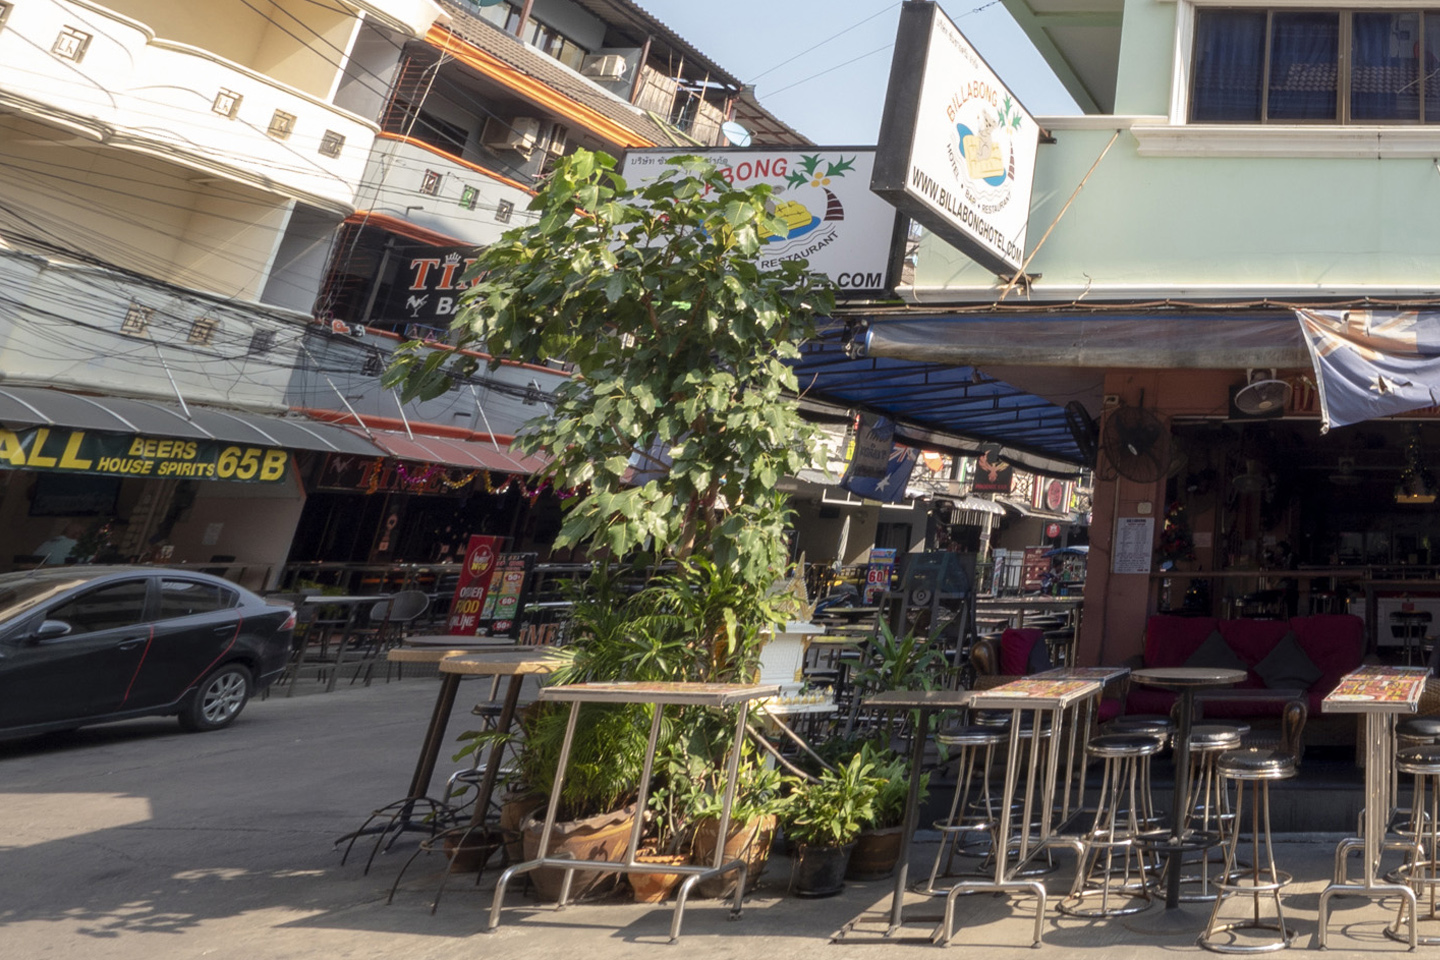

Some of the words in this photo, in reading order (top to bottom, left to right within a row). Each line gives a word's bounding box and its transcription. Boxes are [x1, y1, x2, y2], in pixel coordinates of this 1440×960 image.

[946, 80, 998, 124] BILLABONG
[946, 143, 960, 181] HOTEL
[964, 189, 977, 208] BAR
[981, 191, 1012, 215] RESTAURANT
[912, 165, 1023, 266] WWW.BILLABONGHOTEL.COM
[760, 230, 839, 270] RESTAURANT
[96, 456, 154, 475] HOUSE
[157, 460, 216, 477] SPIRITS
[127, 437, 198, 460] BEERS
[216, 446, 288, 481] 65B
